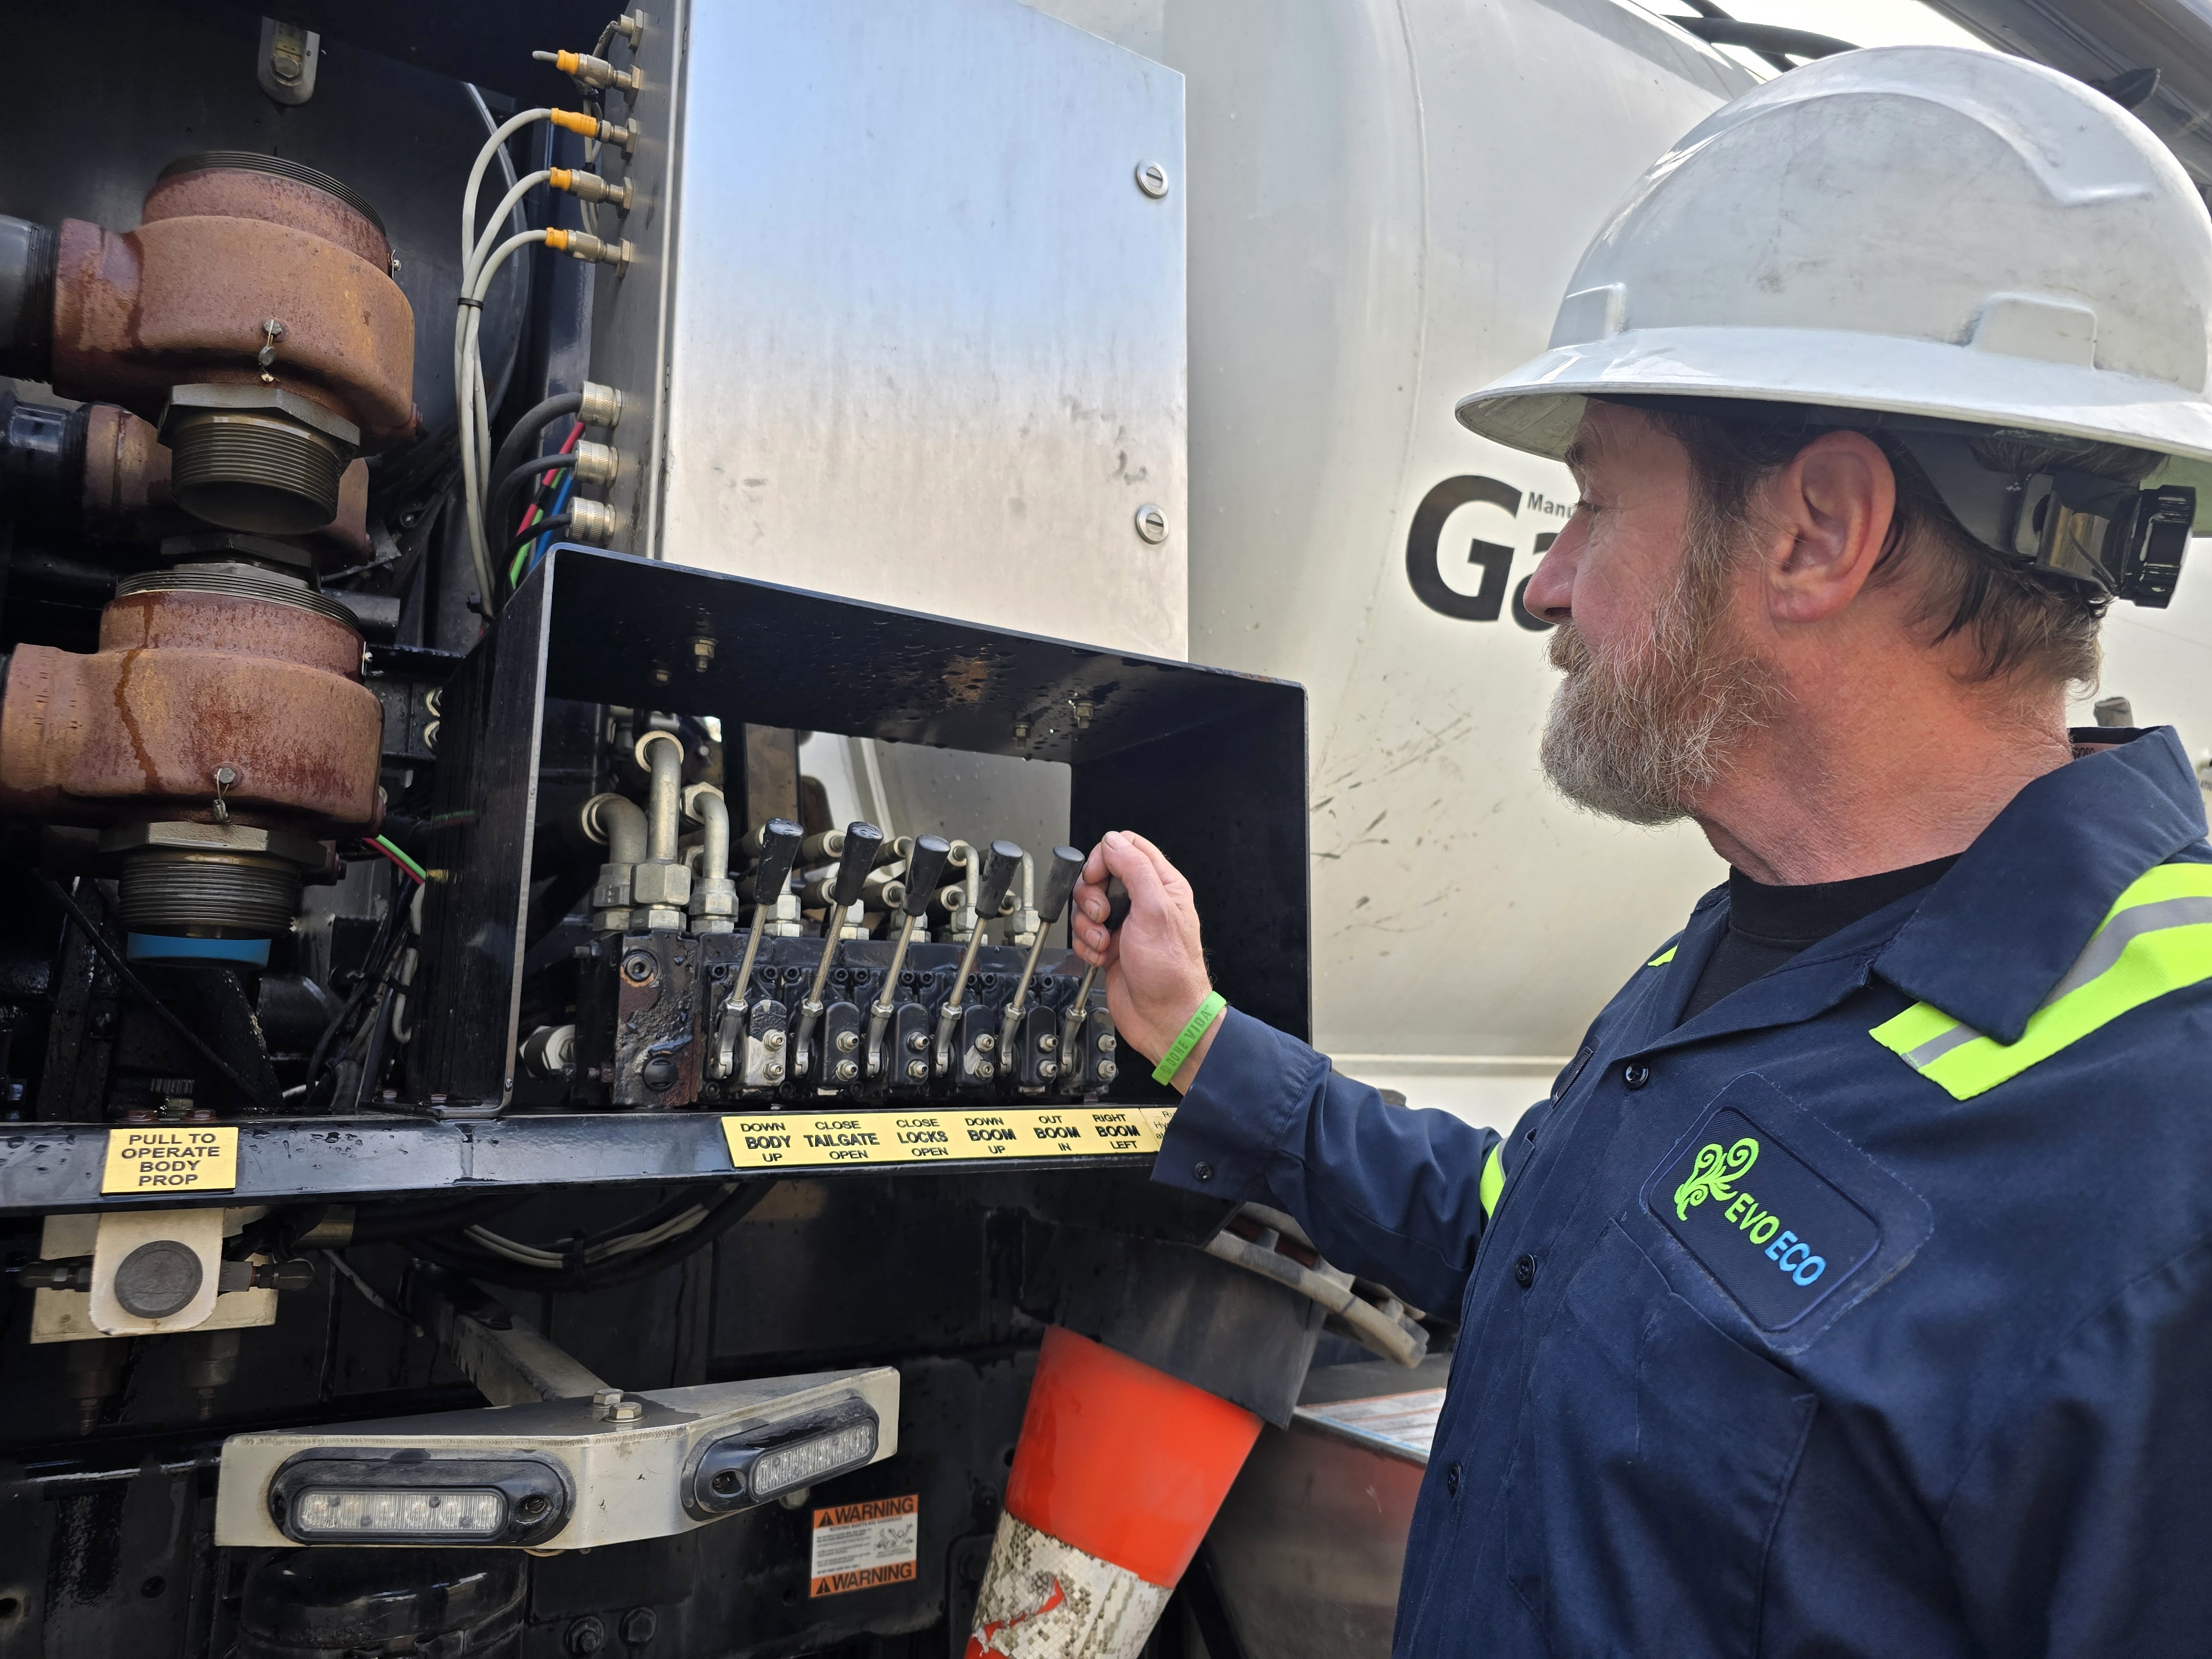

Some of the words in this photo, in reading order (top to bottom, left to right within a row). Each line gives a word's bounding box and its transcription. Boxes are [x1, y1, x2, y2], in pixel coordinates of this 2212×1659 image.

[1166, 1040, 1188, 1067] DONE
[896, 1119, 940, 1128] CLOSE
[964, 1117, 1004, 1126] DOWN
[1039, 1115, 1062, 1124] OUT
[1092, 1114, 1126, 1123] RIGHT
[740, 1122, 786, 1132] DOWN
[815, 1120, 862, 1130] CLOSE
[1095, 1125, 1141, 1137] BOOM
[897, 1130, 948, 1144] LOCKS
[967, 1128, 1016, 1141] BOOM
[1033, 1126, 1081, 1139] BOOM
[129, 1134, 182, 1145] PULL
[189, 1133, 216, 1144] TO
[744, 1135, 791, 1149] BODY
[803, 1133, 880, 1147] TAILGATE
[988, 1145, 1005, 1154] UP
[1058, 1142, 1072, 1151] IN
[1109, 1141, 1138, 1150] LEFT
[122, 1146, 220, 1159] OPERATE
[762, 1153, 782, 1162] UP
[829, 1150, 869, 1160] OPEN
[911, 1147, 948, 1157] OPEN
[140, 1160, 201, 1172] BODY
[139, 1174, 198, 1186] PROP
[834, 1496, 914, 1524] WARNING
[832, 1562, 912, 1591] WARNING
